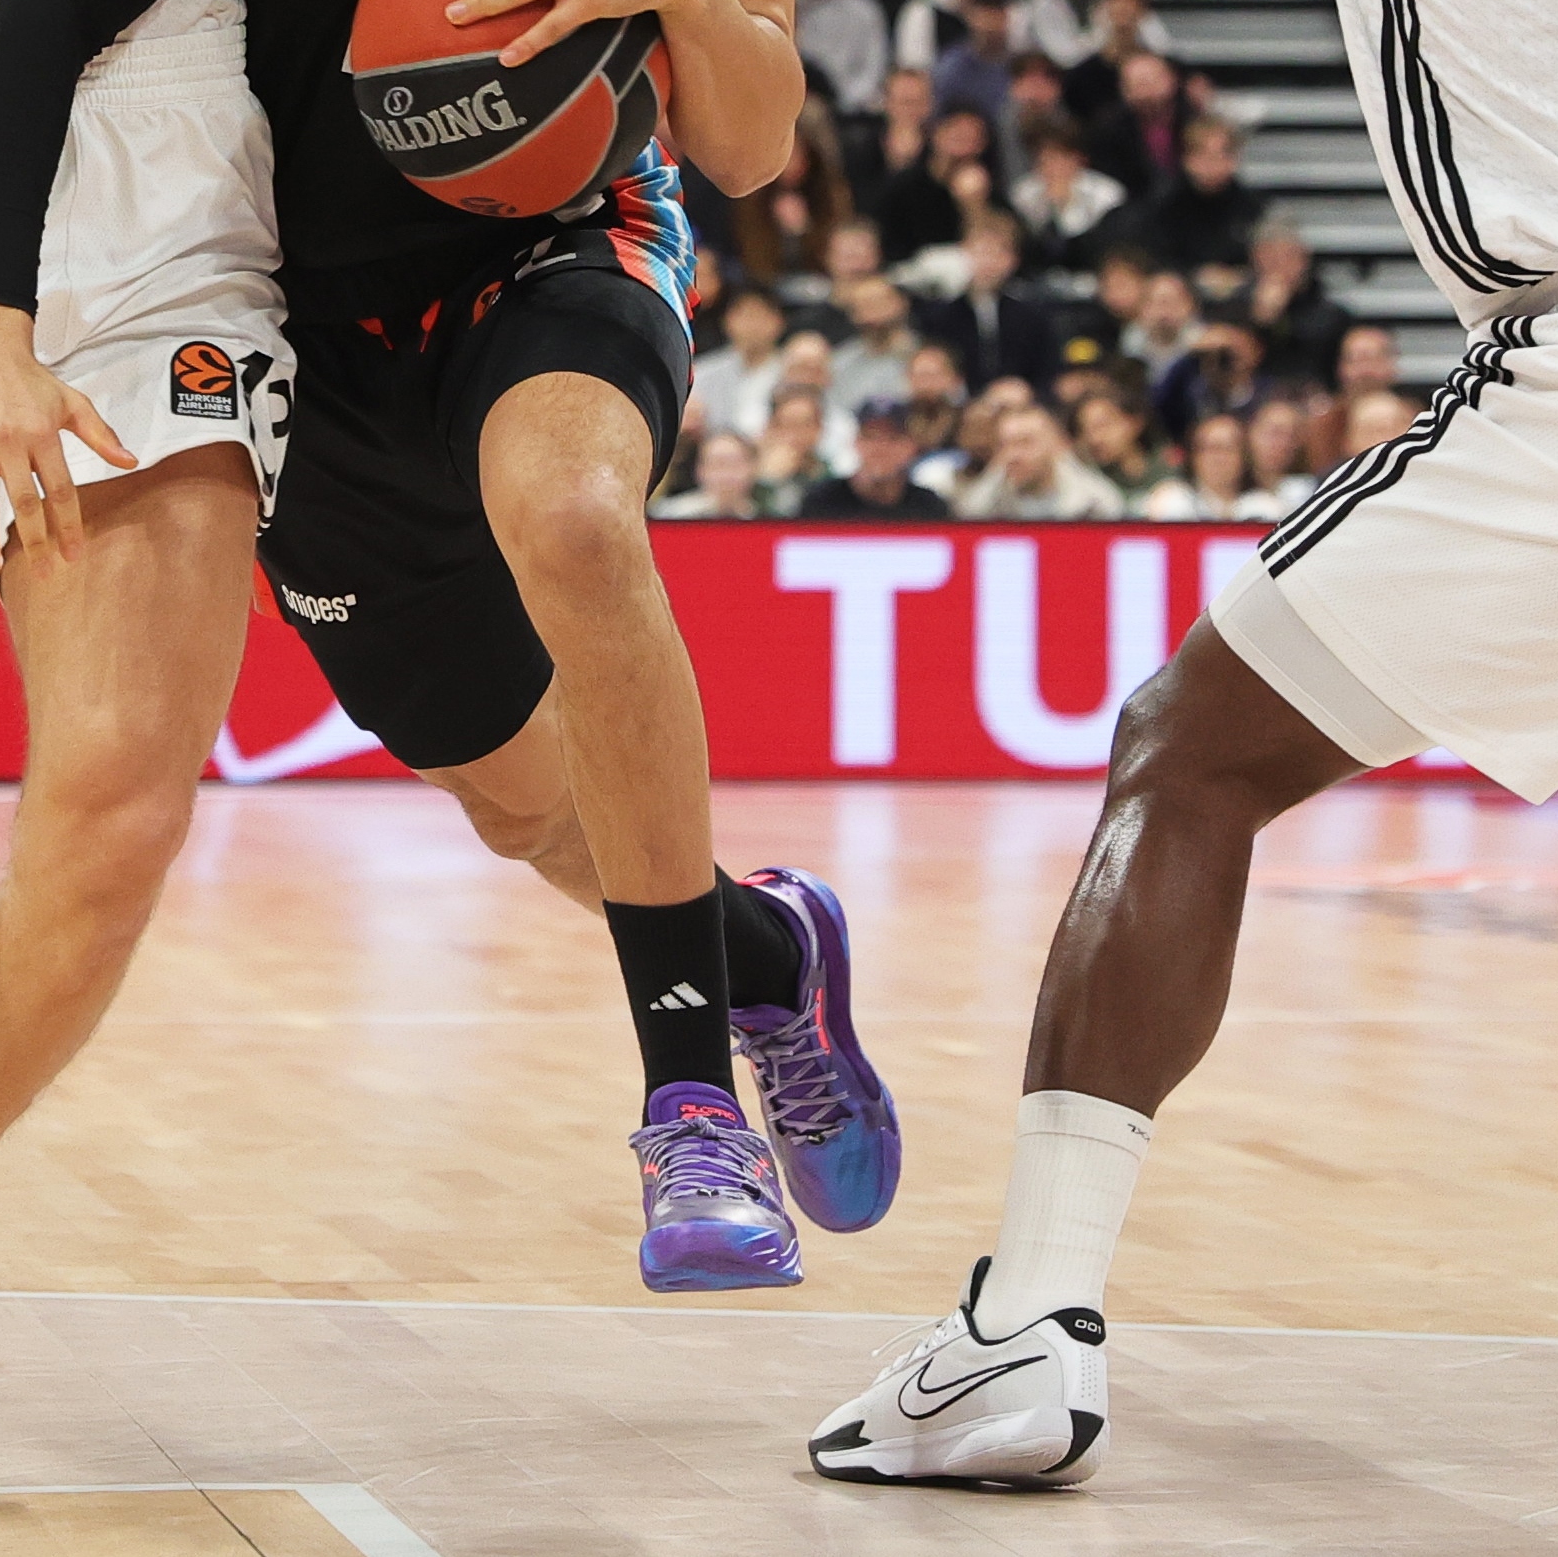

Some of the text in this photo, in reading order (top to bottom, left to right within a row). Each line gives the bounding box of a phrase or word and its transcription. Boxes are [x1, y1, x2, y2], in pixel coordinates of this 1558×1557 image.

[360, 79, 520, 152] PALDING
[176, 392, 232, 405] TURKISH
[177, 401, 233, 413] AIRLINES
[1074, 1318, 1102, 1335] 001
